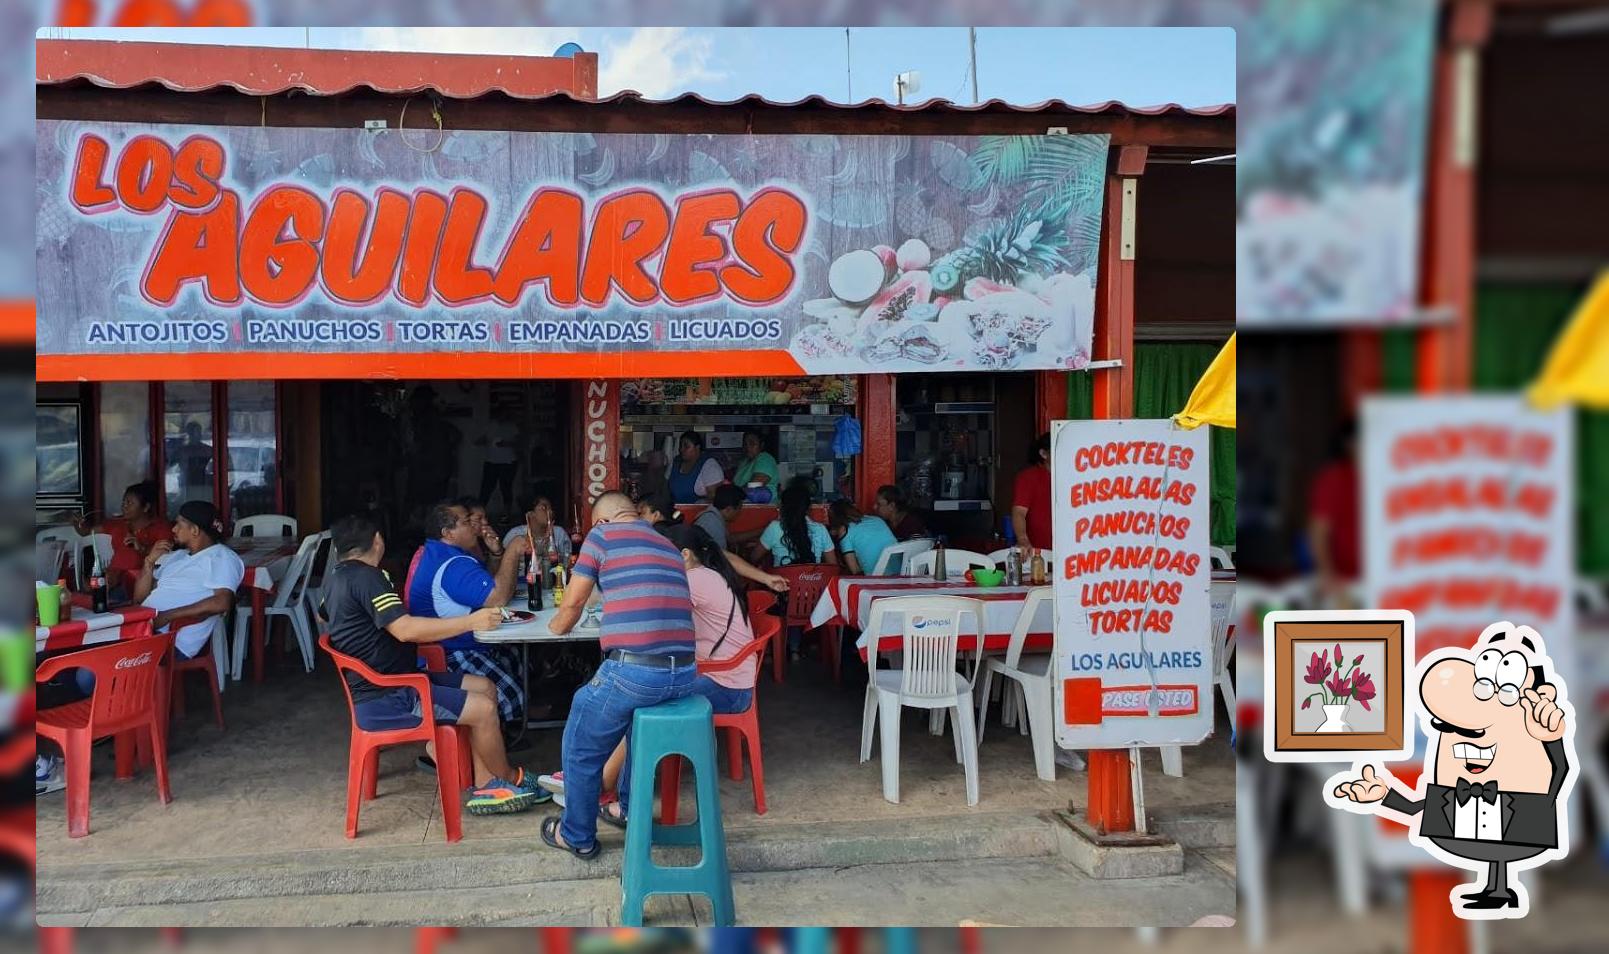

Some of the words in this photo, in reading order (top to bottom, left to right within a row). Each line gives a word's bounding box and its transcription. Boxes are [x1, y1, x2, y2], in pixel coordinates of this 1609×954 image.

[71, 134, 224, 214] LOS
[142, 184, 809, 308] AGUILARES
[88, 322, 227, 343] ANTOJITOS
[248, 320, 381, 342] PANUCHOS
[400, 322, 488, 341] TORTAS
[509, 322, 650, 342] EMPANADAS
[670, 320, 780, 340] LICUADOS
[1074, 441, 1194, 472] COCKTELES
[1070, 476, 1196, 508] ENSALADAS
[1075, 510, 1191, 543] PANUCHOS
[1064, 546, 1200, 580] EMPANADAS
[1081, 579, 1183, 608] LICUADOS
[927, 618, 951, 627] pepsi
[1089, 608, 1174, 635] TORTAS
[115, 652, 153, 670] Coca-Cola
[1071, 654, 1102, 671] LOS
[1102, 692, 1139, 708] PASE
